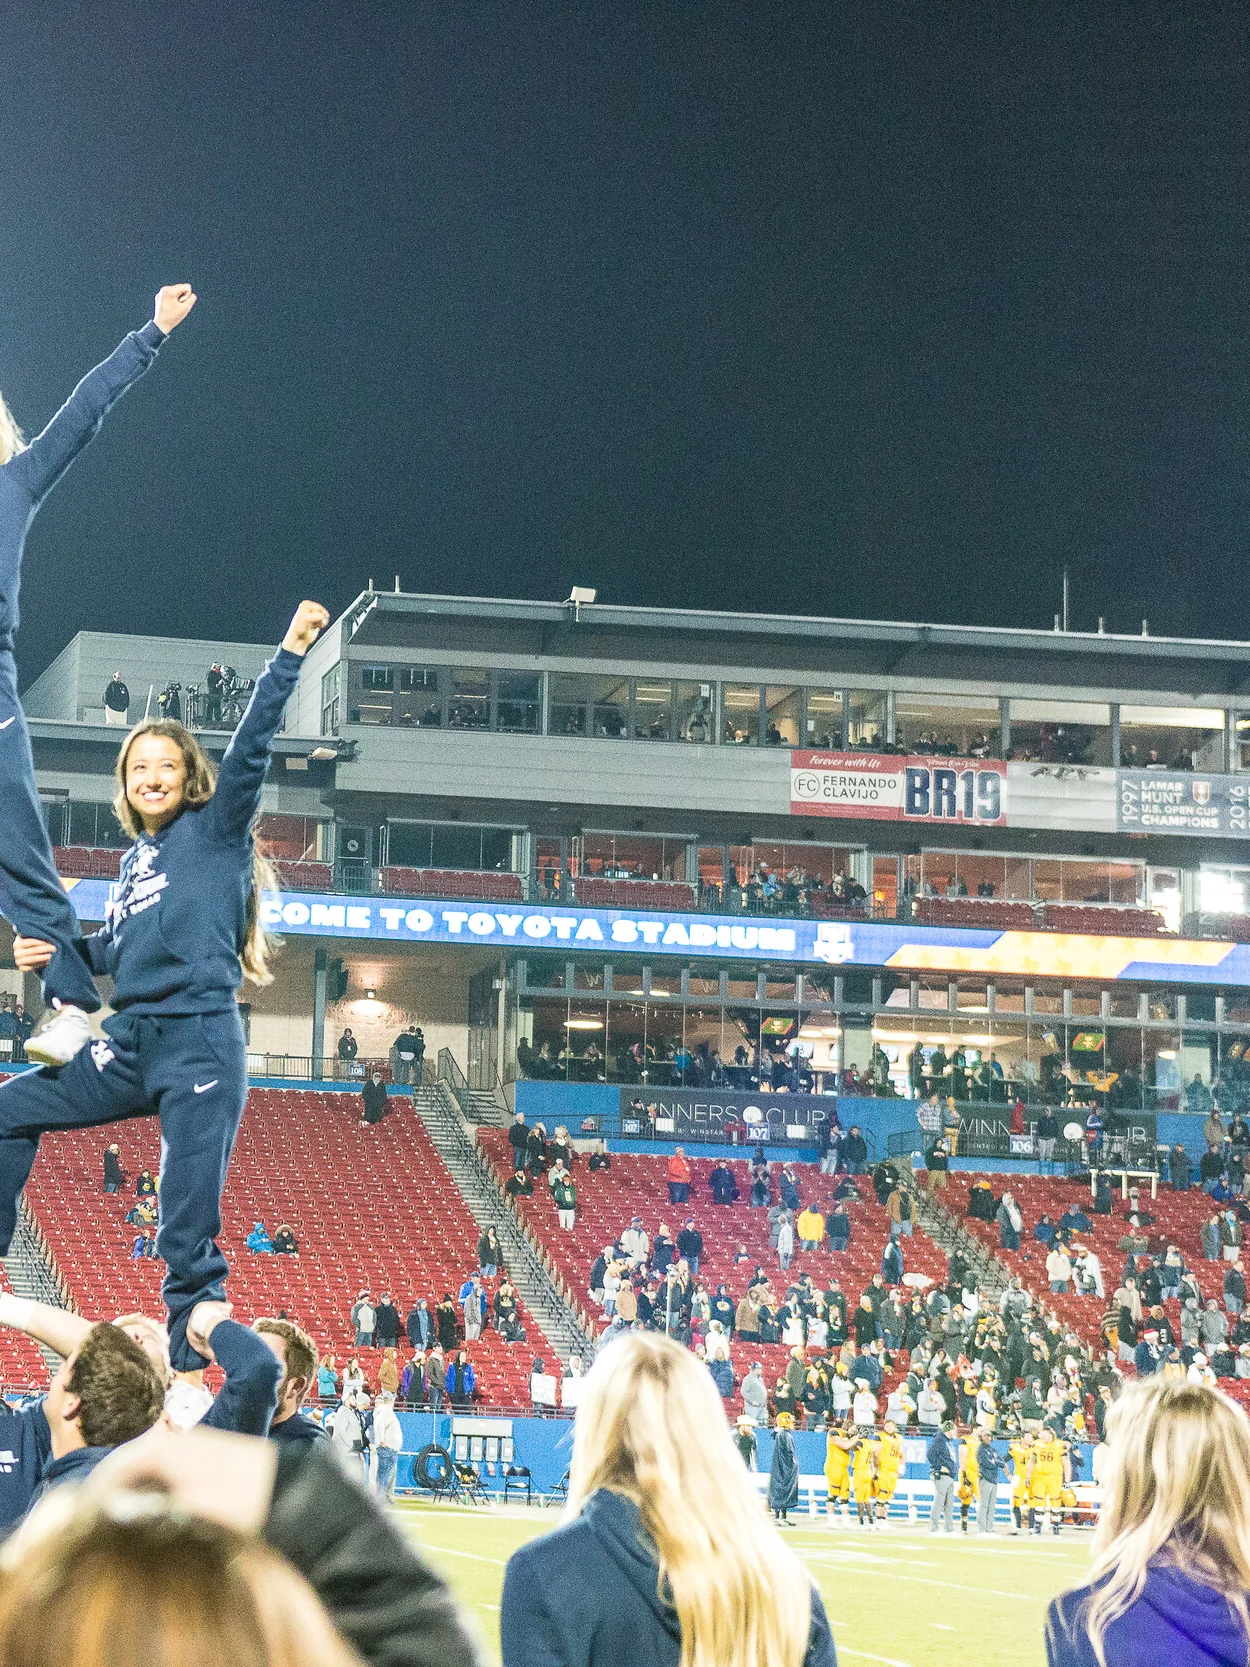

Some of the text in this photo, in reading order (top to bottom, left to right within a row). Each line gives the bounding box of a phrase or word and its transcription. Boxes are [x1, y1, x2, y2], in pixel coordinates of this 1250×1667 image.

[809, 755, 881, 768] Forever with Us
[797, 778, 817, 792] FC
[823, 775, 897, 789] FERNANDO
[1141, 780, 1184, 793] LAMAR
[823, 787, 879, 800] CLAVIJO
[904, 766, 1002, 822] BR19
[1141, 791, 1183, 804] HUNT
[1121, 780, 1139, 824] 1997
[1229, 785, 1246, 829] 2016
[1141, 803, 1219, 817] U.S. OPEN CUP
[1141, 814, 1220, 829] CHAMPIONS
[259, 901, 796, 952] COME TO TOYOTA STADIUM
[748, 1127, 768, 1140] 107
[1012, 1140, 1031, 1154] 106
[906, 1447, 926, 1463] 07
[1039, 1451, 1054, 1462] 56
